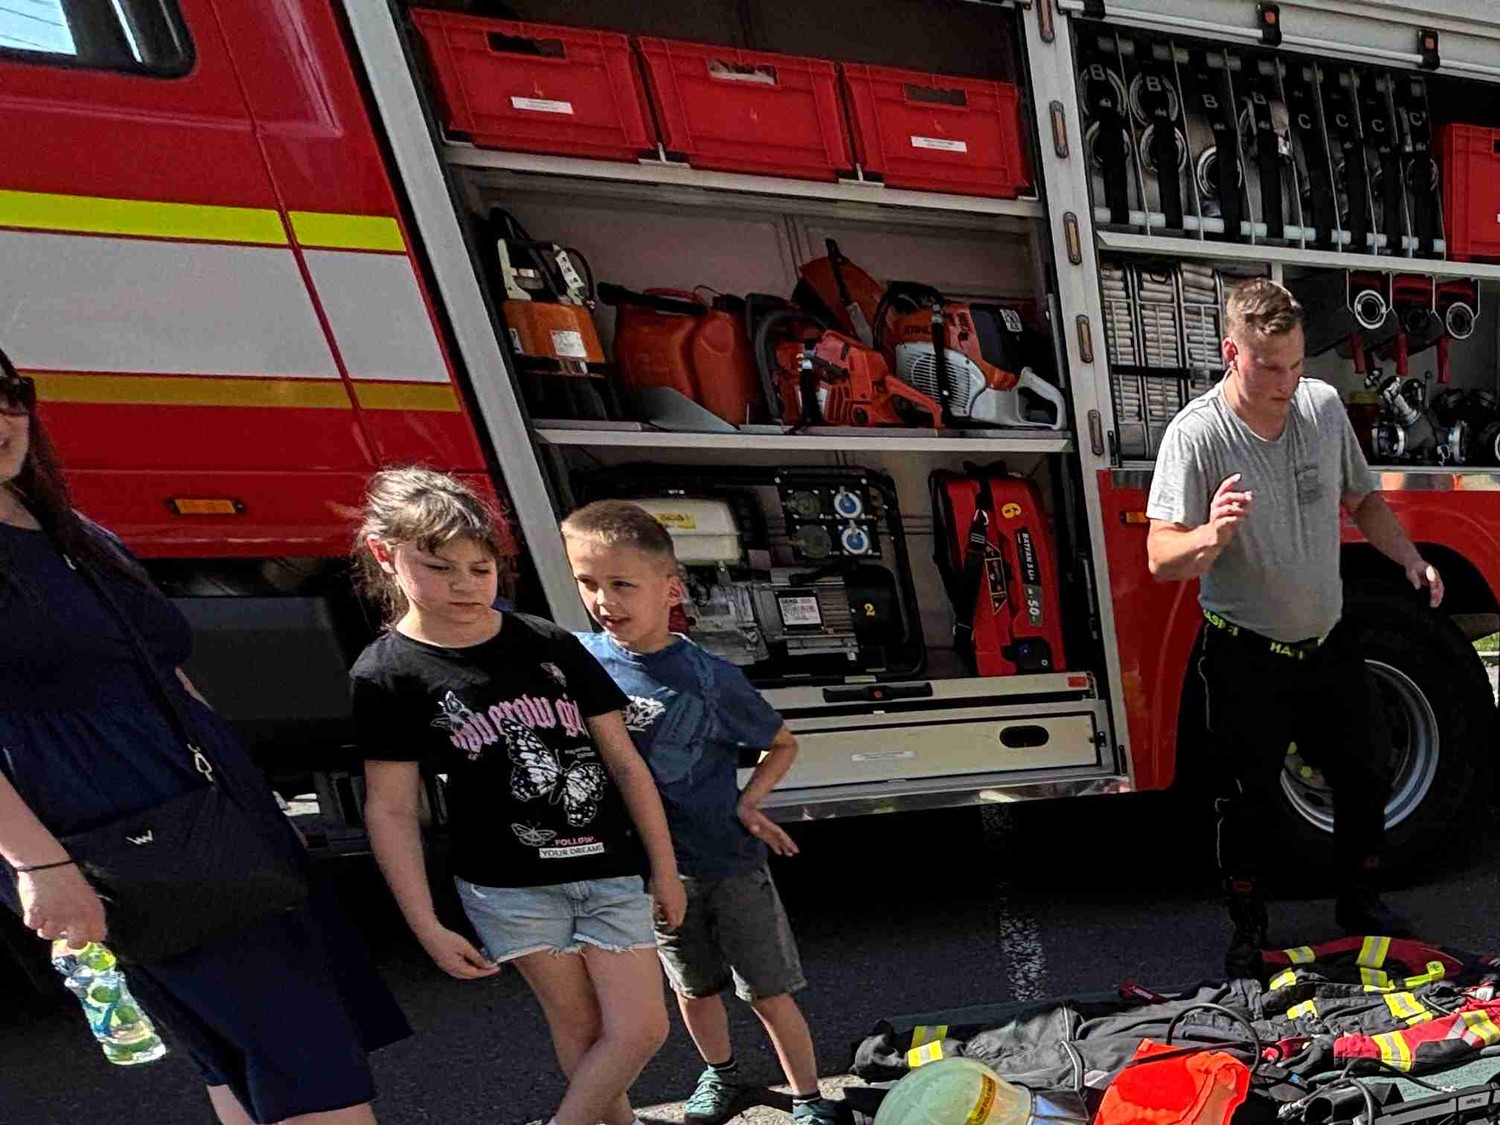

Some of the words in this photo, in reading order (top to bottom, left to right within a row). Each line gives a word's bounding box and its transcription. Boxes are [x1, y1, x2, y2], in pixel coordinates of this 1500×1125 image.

[1089, 64, 1106, 81] B
[1146, 76, 1162, 92] B
[1202, 94, 1218, 108] B
[1298, 114, 1311, 129] C
[1336, 114, 1349, 127] C
[1371, 119, 1385, 132] C
[1409, 112, 1422, 126] C
[1001, 503, 1022, 519] 6
[864, 603, 876, 616] 2
[1027, 599, 1041, 616] 50
[540, 848, 569, 857] YOUR
